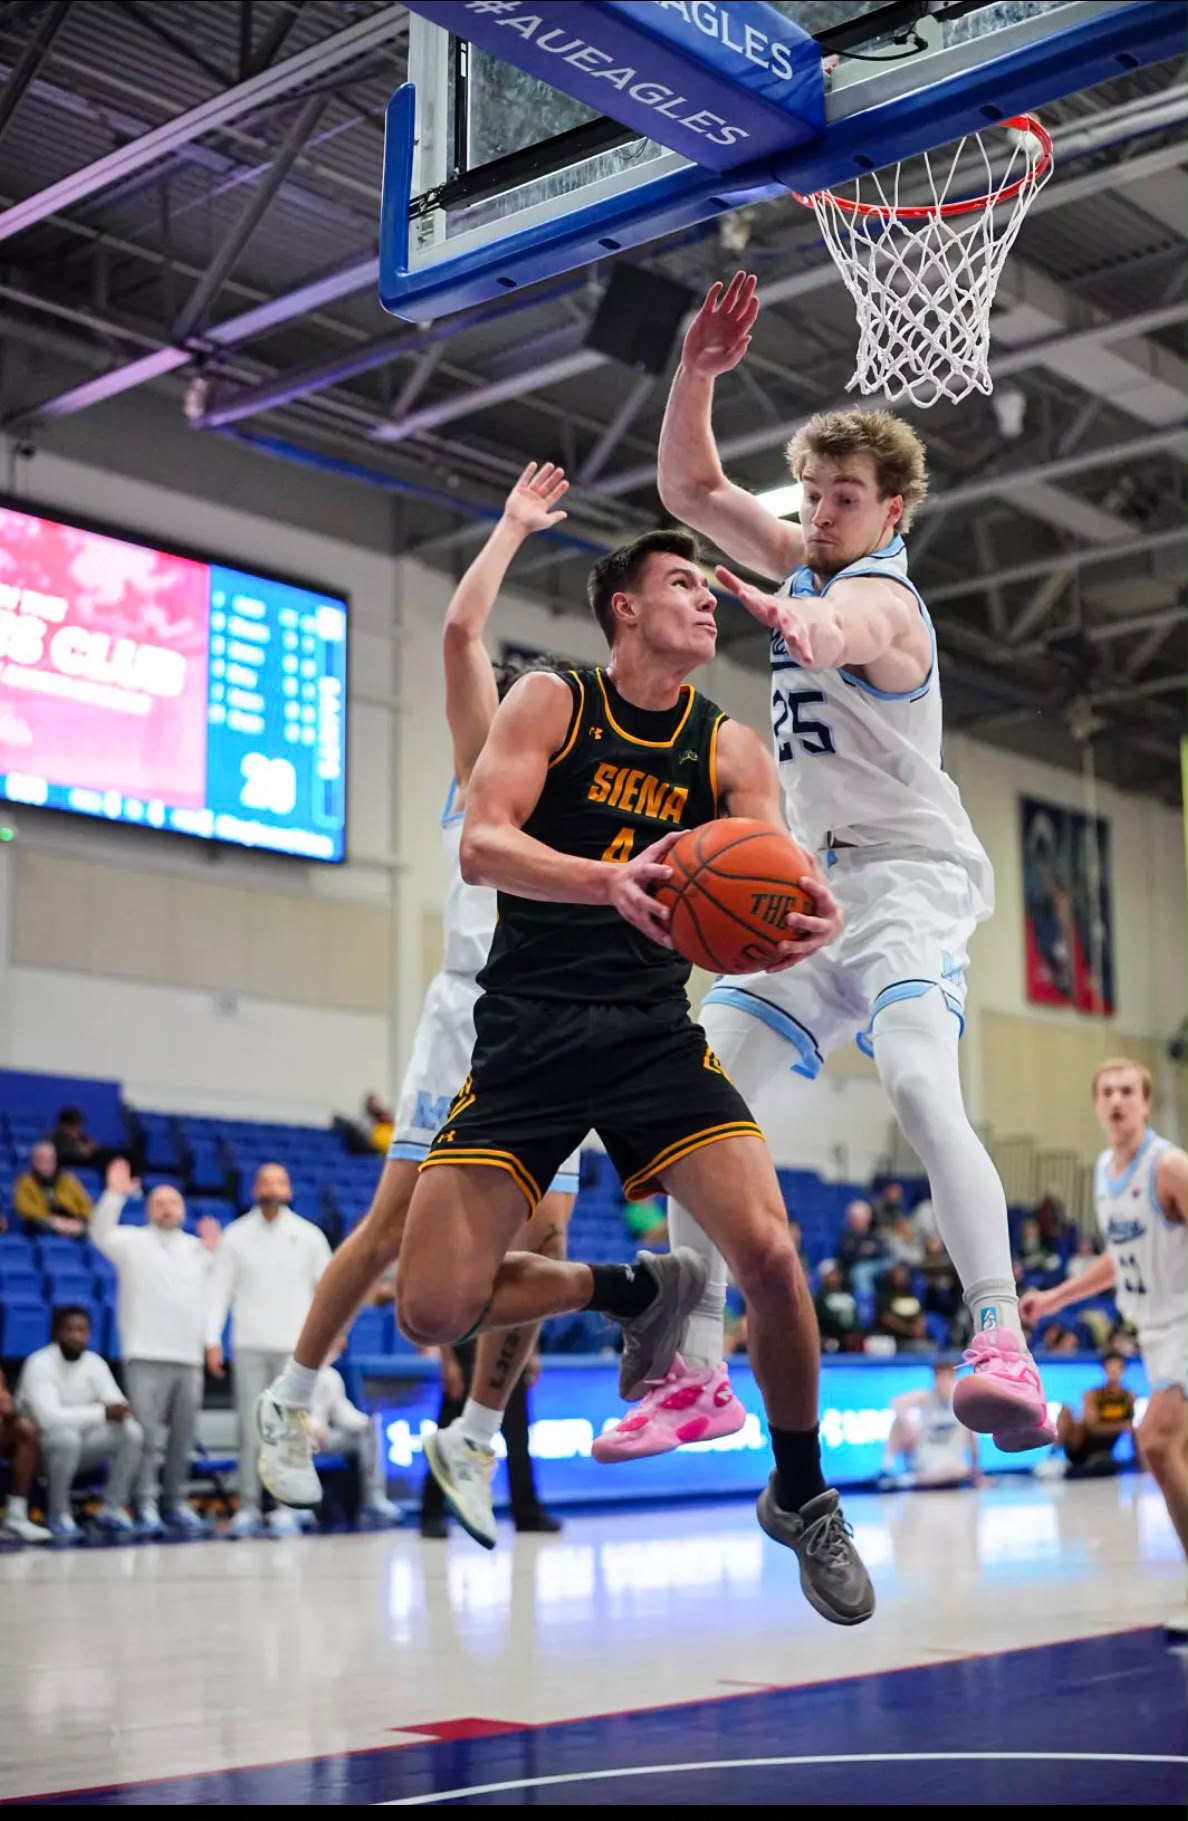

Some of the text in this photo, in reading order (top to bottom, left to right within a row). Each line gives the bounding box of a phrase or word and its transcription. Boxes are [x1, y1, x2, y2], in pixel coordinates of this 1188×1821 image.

[464, 1, 751, 146] #AUEAGLES
[656, 1, 793, 80] AGLES
[772, 689, 837, 762] 25
[588, 762, 689, 824] SIENA
[602, 827, 636, 863] 4
[750, 893, 797, 931] THE
